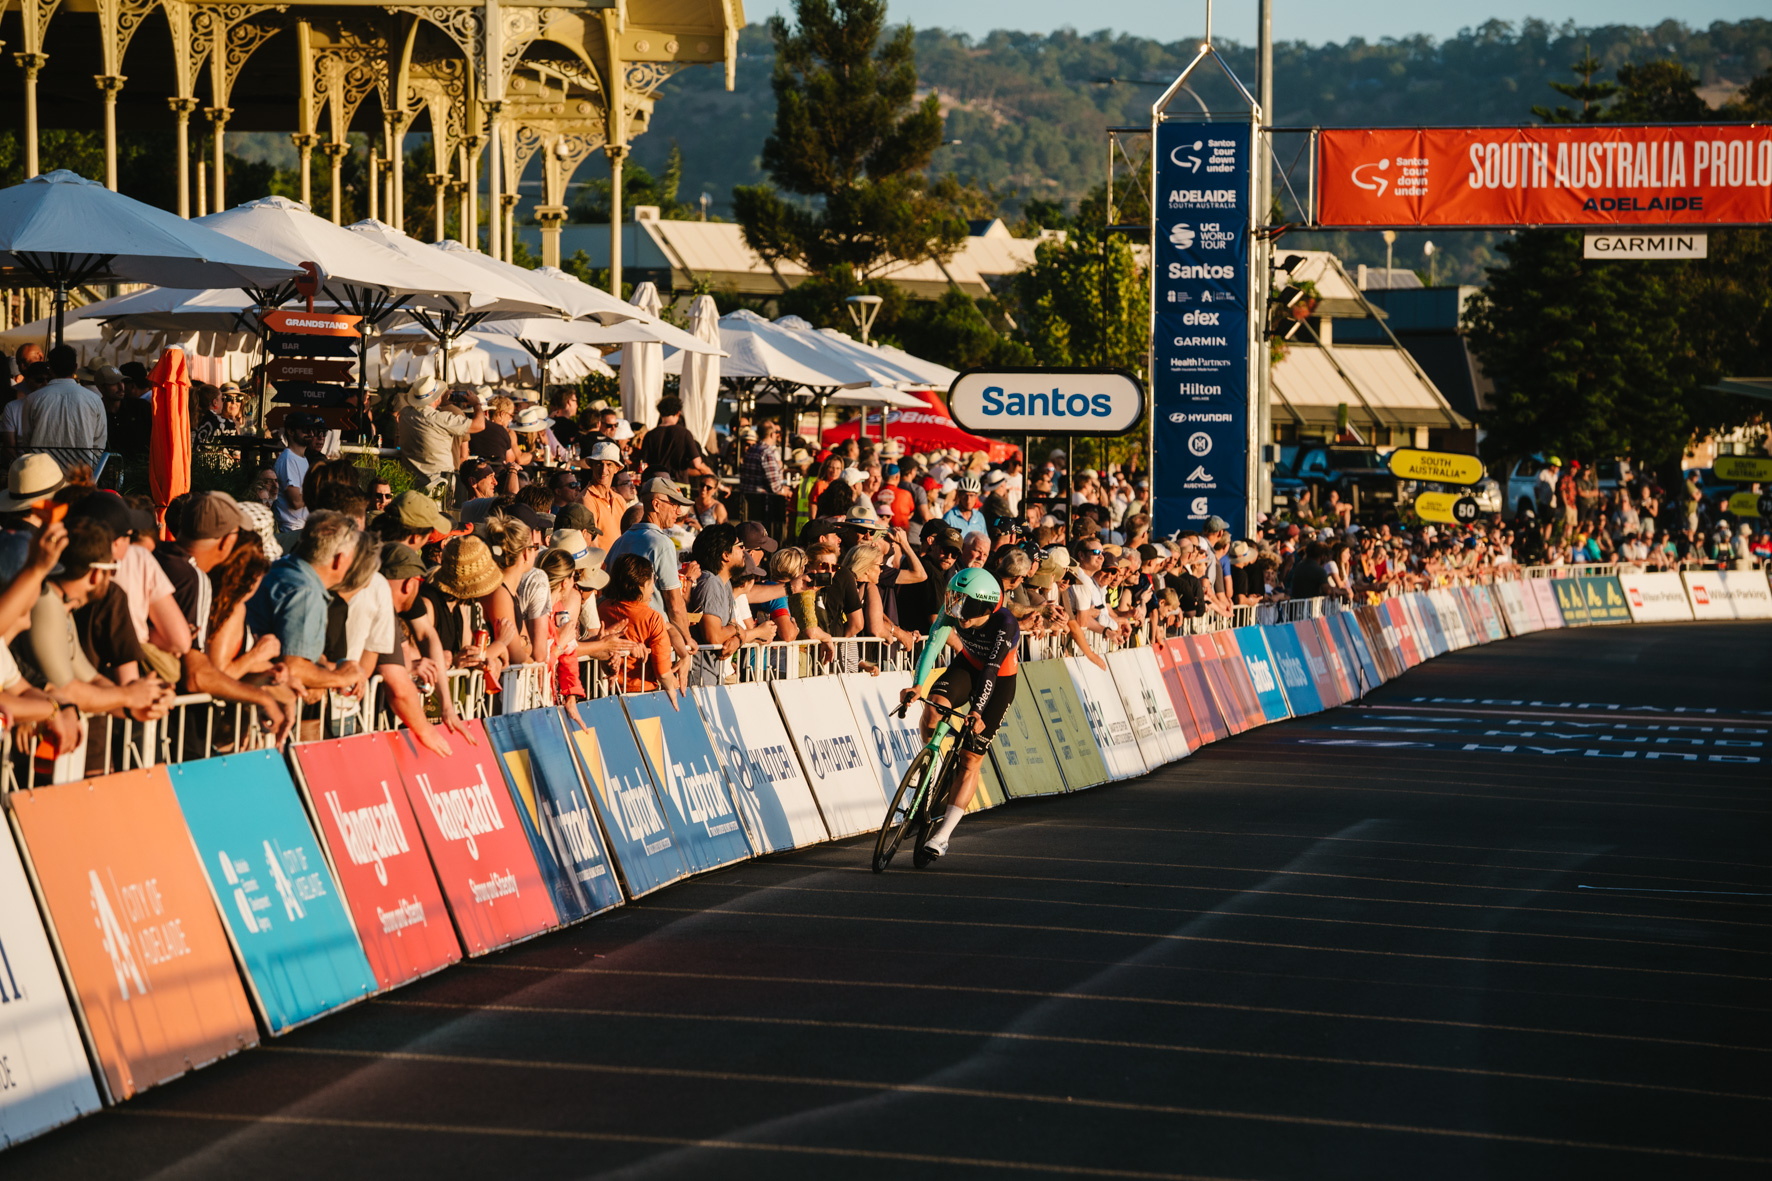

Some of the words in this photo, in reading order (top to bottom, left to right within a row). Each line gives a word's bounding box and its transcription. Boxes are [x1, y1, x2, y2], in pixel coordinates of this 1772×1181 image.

[1207, 139, 1236, 147] Santos
[1213, 148, 1236, 156] tour
[1209, 155, 1235, 164] down
[1396, 157, 1429, 166] Santos
[1469, 142, 1547, 190] SOUTH
[1555, 141, 1686, 188] AUSTRALIA
[1206, 164, 1236, 172] under
[1403, 167, 1429, 176] tour
[1397, 176, 1429, 186] down
[1169, 190, 1236, 203] ADELAIDE
[1394, 187, 1429, 196] under
[1582, 196, 1703, 211] ADELAIDE
[1200, 223, 1220, 232] UCI
[1200, 231, 1235, 241] WORLD
[1200, 240, 1226, 249] TOUR
[1594, 236, 1693, 252] GARMIN
[1168, 262, 1235, 279] Santos
[1182, 309, 1220, 326] efex
[285, 318, 348, 330] GRANDSTAND
[281, 342, 300, 350] BAR
[1173, 337, 1226, 346] GARMIN
[281, 366, 314, 375] COFFEE
[302, 390, 326, 399] TOILET
[1180, 382, 1222, 396] Hilton
[981, 386, 1112, 418] Santos
[1188, 413, 1233, 423] HYUNDAI
[1420, 456, 1452, 467] SOUTH
[1183, 482, 1217, 490] AUSCYCLING
[1458, 503, 1475, 518] 50
[1708, 590, 1734, 600] Wilson
[988, 628, 1007, 660] Adecco
[975, 679, 994, 711] Adecco
[816, 734, 863, 774] HYUNDAI
[746, 743, 797, 785] HYUNDAI
[672, 754, 734, 838] Ziptrak
[415, 763, 505, 861] Vanguard
[610, 766, 666, 857] Ziptrak
[324, 780, 411, 887] Vanguard
[121, 883, 151, 923] CITY
[145, 878, 165, 916] OF
[138, 917, 191, 967] ADELAIDE
